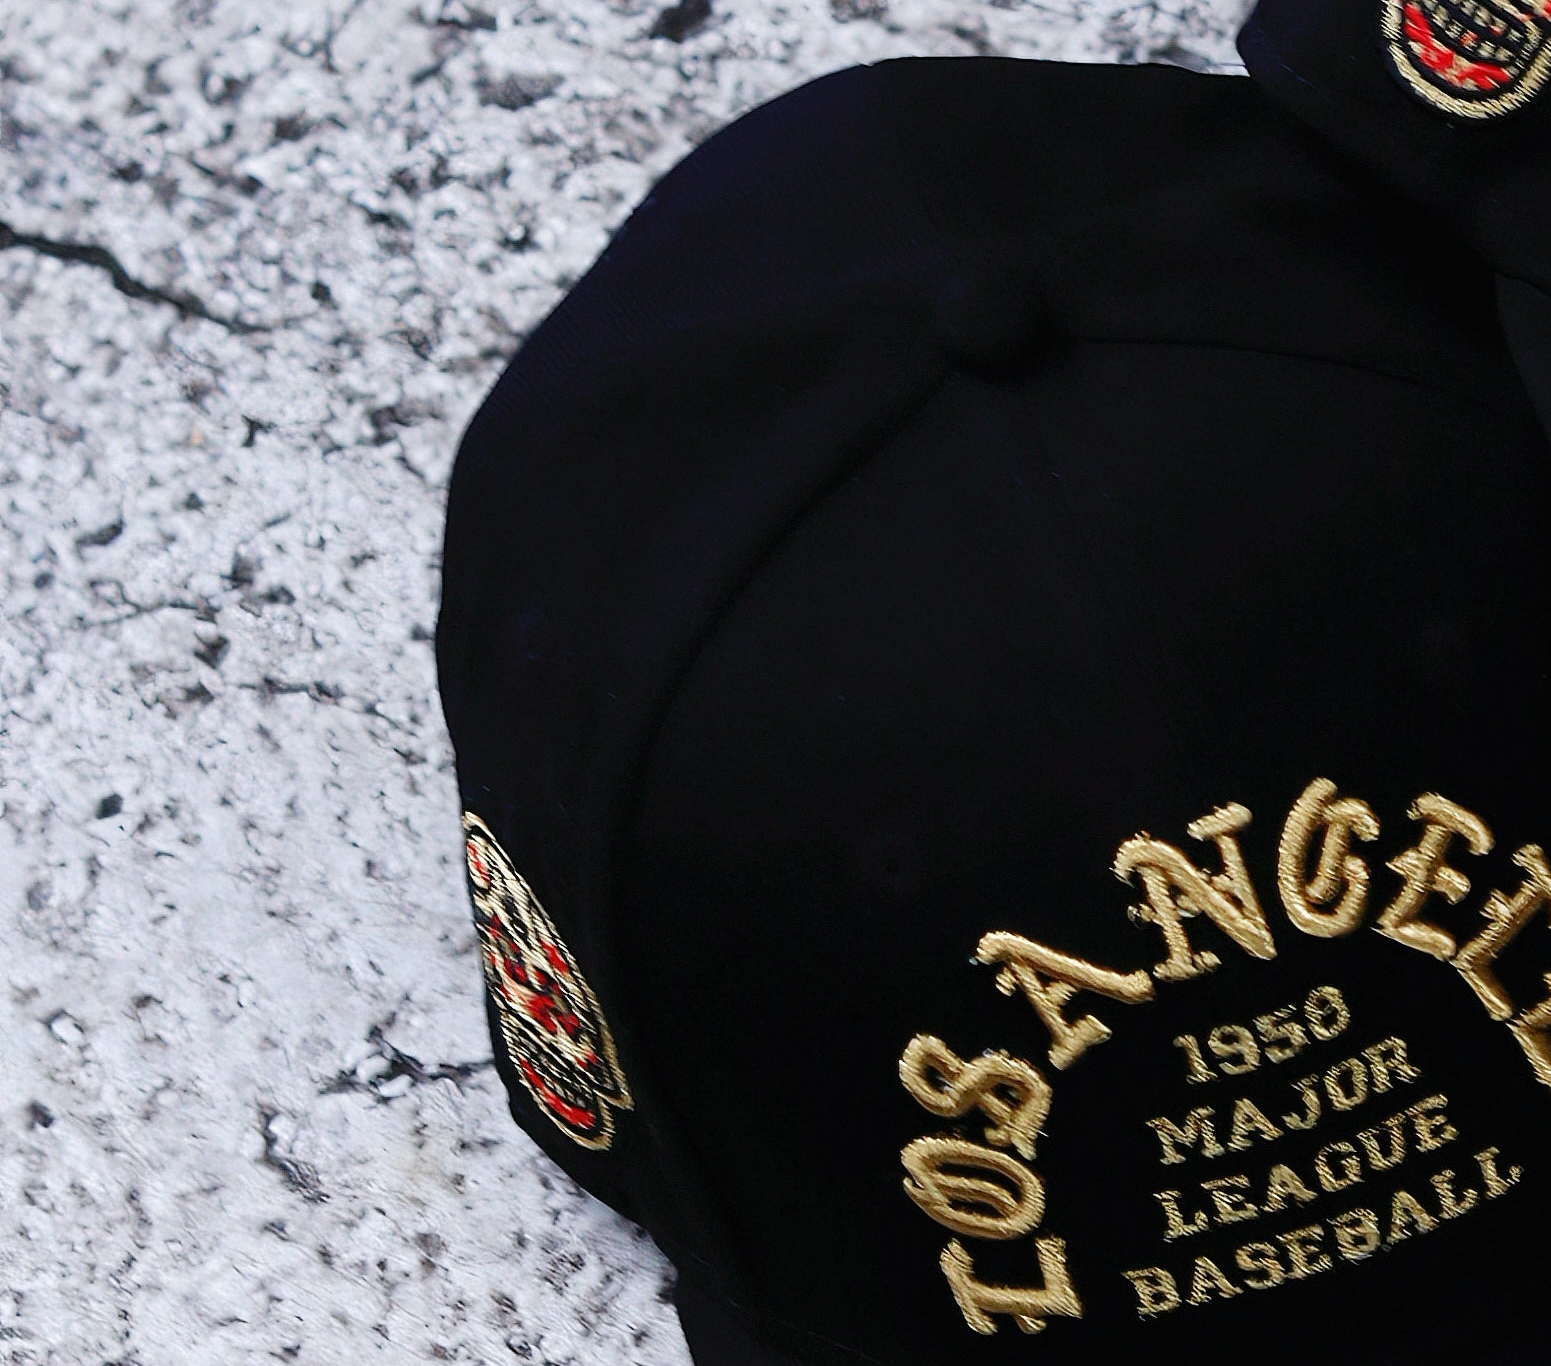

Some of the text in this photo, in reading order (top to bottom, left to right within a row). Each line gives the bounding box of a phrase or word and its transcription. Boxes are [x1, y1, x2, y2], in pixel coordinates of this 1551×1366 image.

[1146, 1037, 1421, 1166] MAJOR
[1154, 1095, 1458, 1244] LEAGUE
[900, 1035, 1082, 1336] LOS
[1123, 1147, 1522, 1320] BASEBALL
